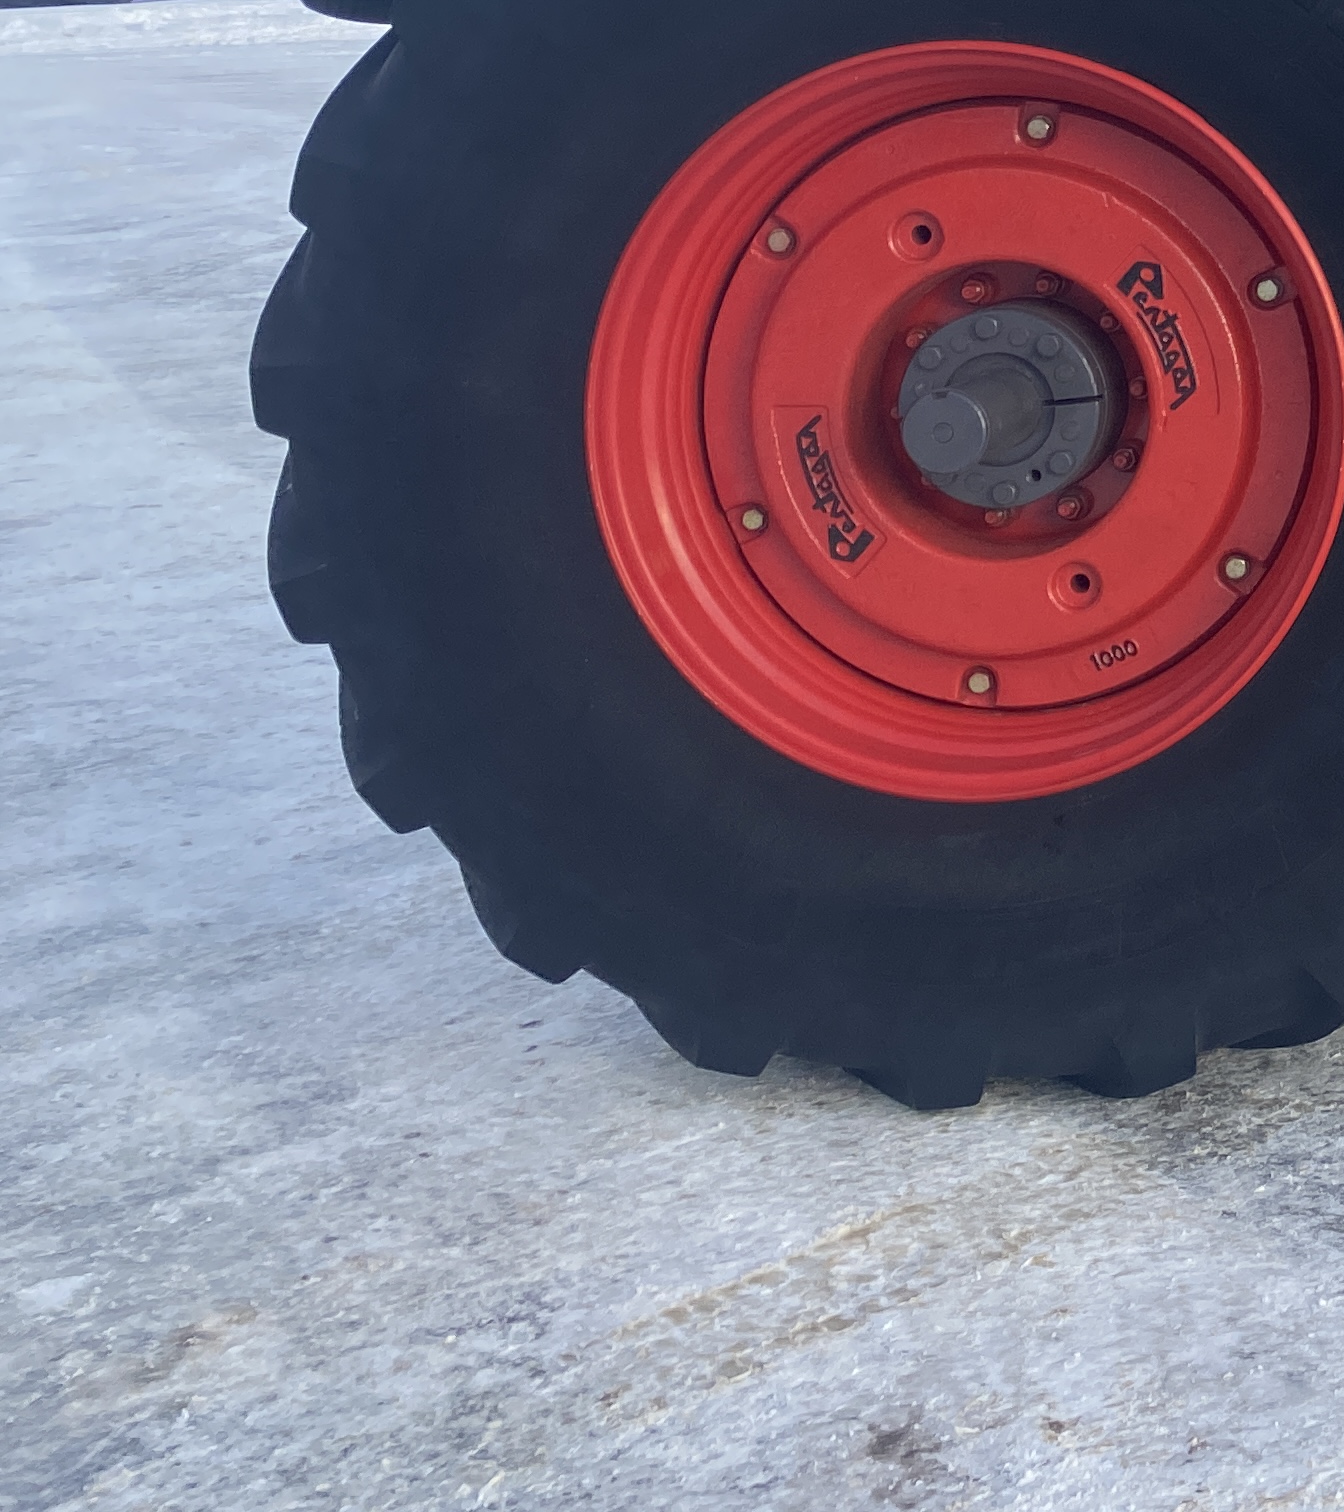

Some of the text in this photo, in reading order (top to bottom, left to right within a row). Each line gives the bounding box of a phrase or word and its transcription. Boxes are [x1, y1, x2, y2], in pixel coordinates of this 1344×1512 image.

[1116, 261, 1197, 411] Pentagon
[796, 415, 875, 563] Pentagon
[1090, 639, 1139, 671] 1000
